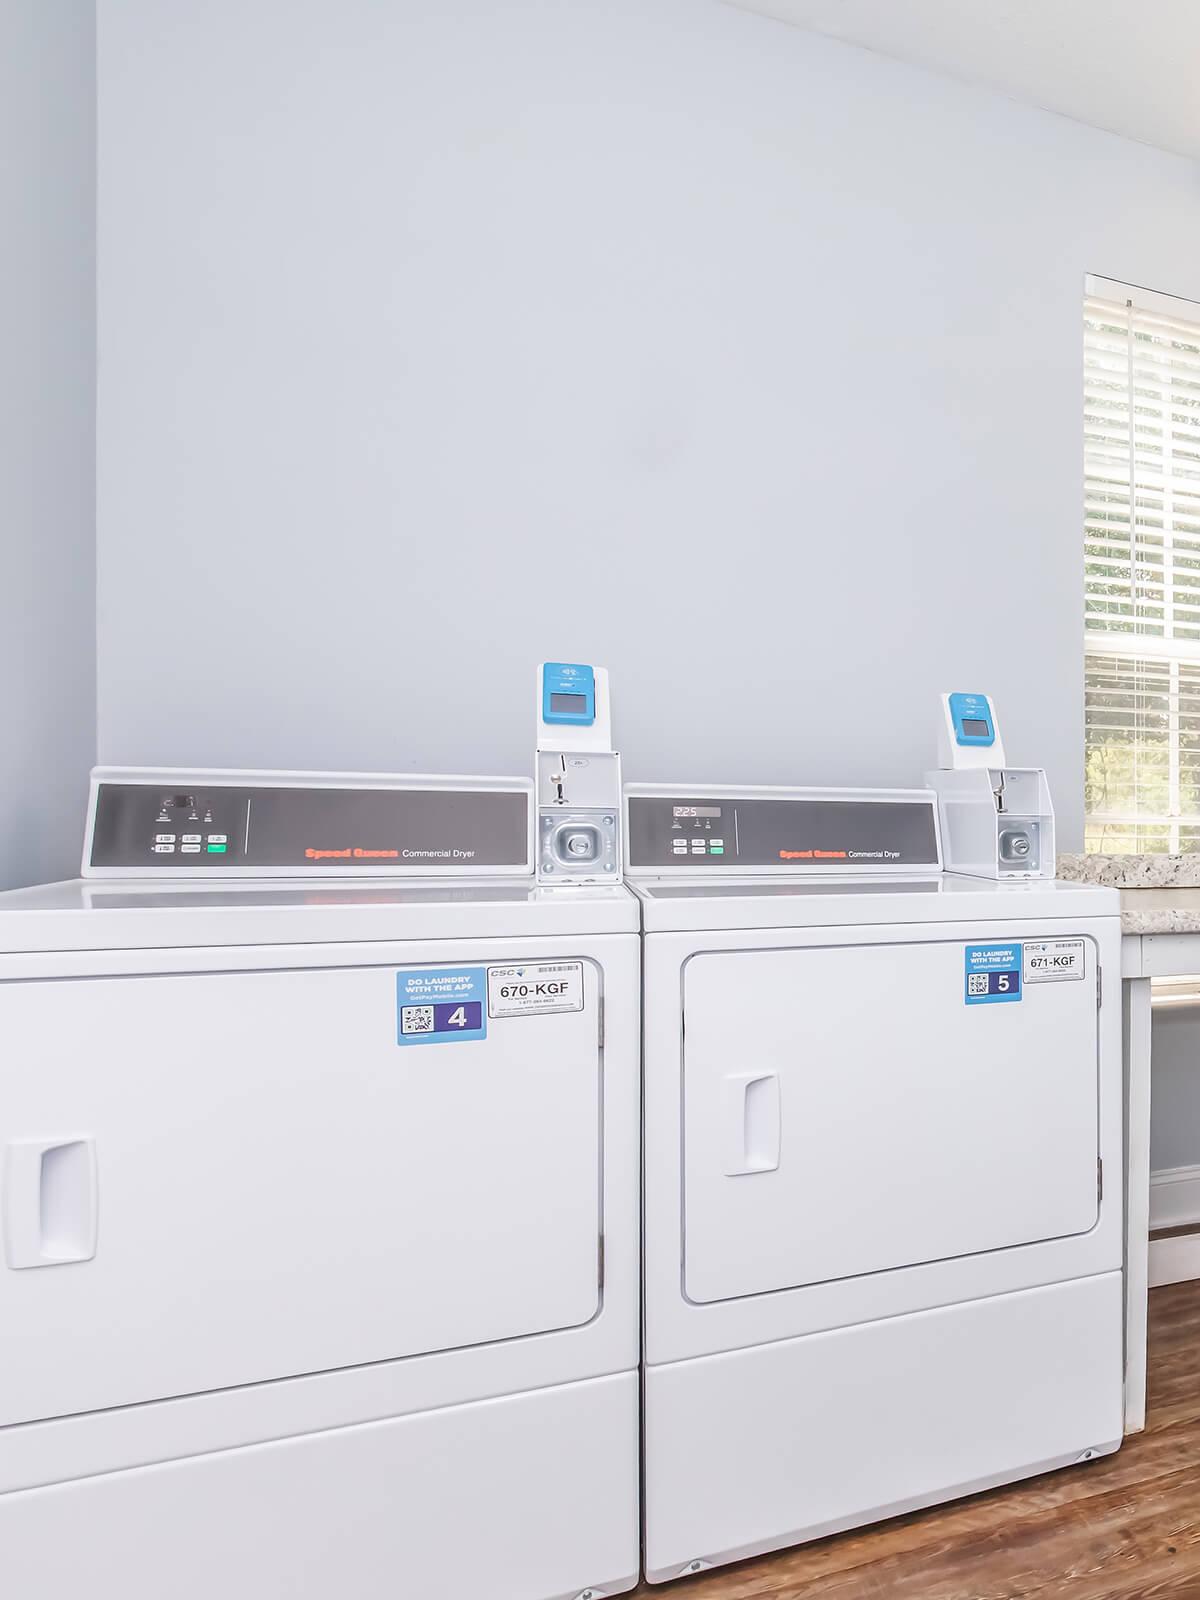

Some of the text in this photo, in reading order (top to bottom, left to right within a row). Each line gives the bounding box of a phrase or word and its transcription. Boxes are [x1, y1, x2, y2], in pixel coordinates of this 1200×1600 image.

[401, 849, 451, 858] Commercial
[452, 849, 476, 860] Dryer
[848, 850, 884, 858] Commercial
[884, 850, 901, 859] Dryer
[1030, 956, 1076, 968] 671-KGF
[491, 969, 515, 977] CSC
[407, 976, 471, 986] DO LAUNDRY
[998, 975, 1010, 991] 5
[404, 983, 474, 993] WITH THE APP
[500, 982, 569, 998] 670-KGF
[447, 1006, 468, 1027] 4
